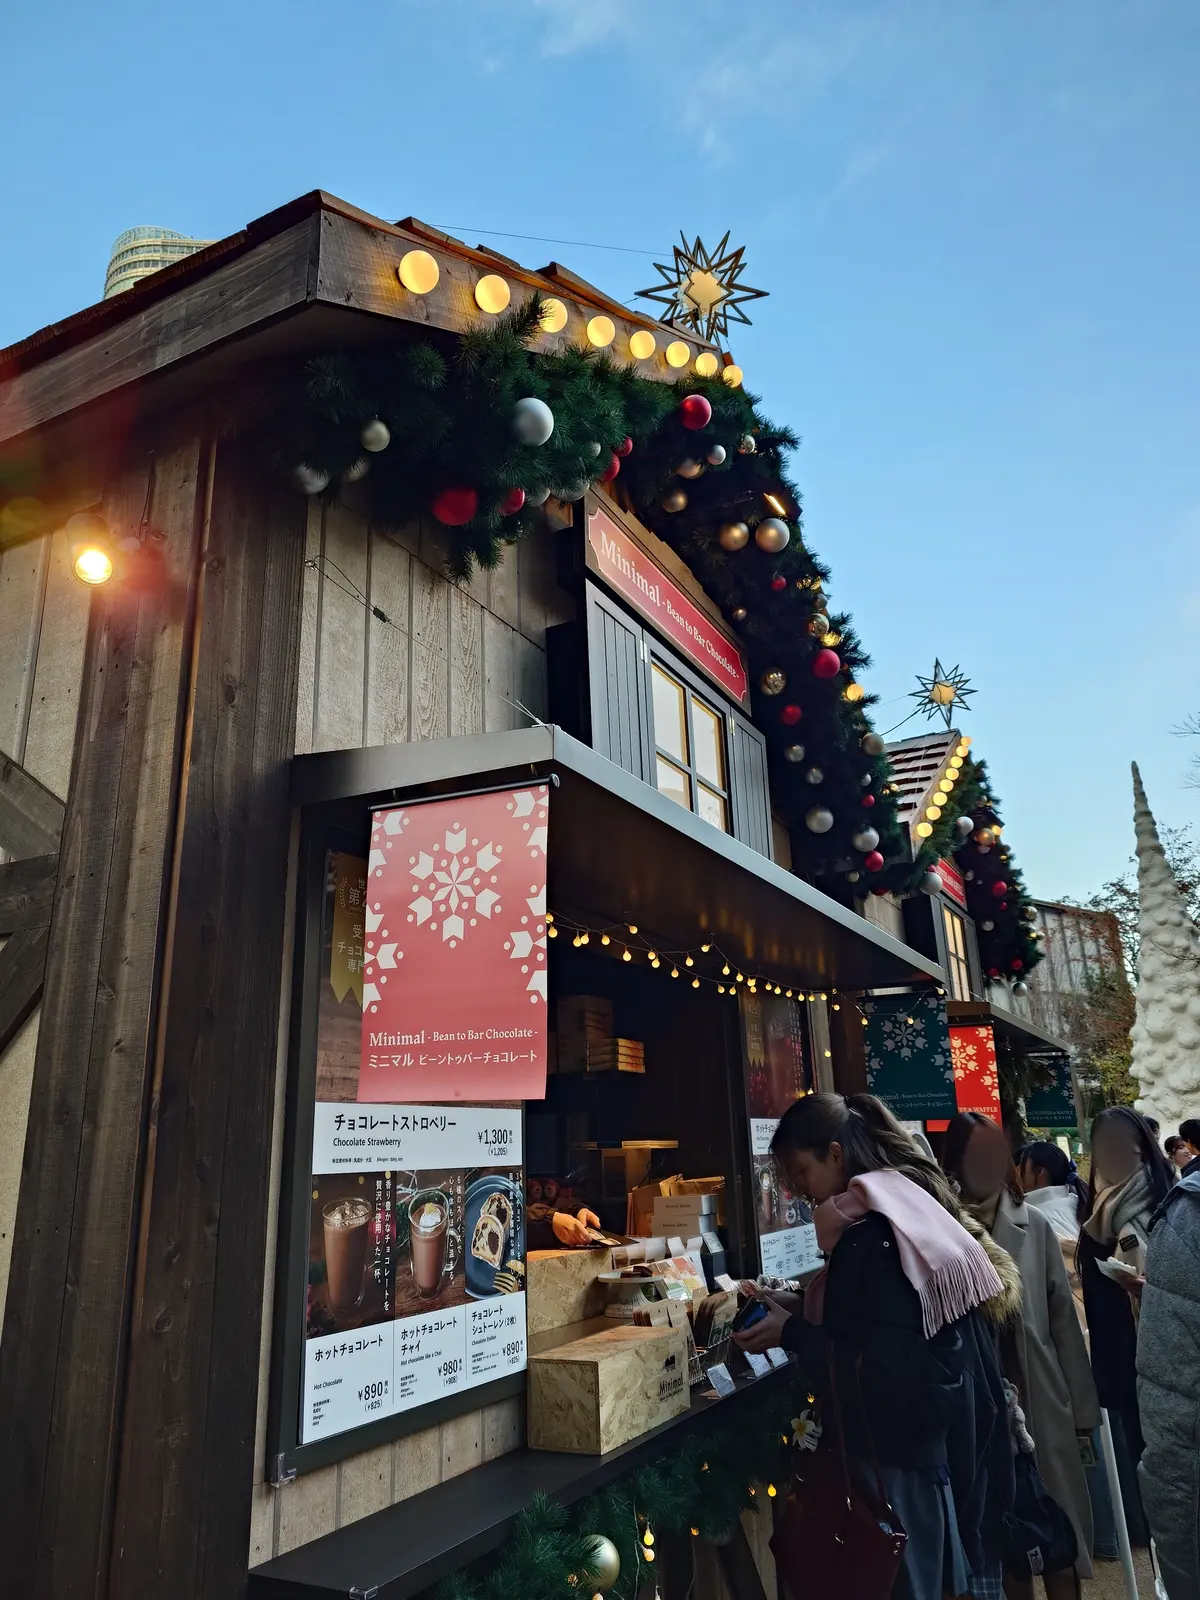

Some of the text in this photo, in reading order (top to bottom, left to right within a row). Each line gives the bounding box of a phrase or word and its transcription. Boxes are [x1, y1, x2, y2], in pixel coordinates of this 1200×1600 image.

[600, 529, 661, 607] Minimal
[666, 599, 685, 628] Bean
[685, 620, 693, 635] to
[693, 626, 706, 648] Bar
[705, 640, 737, 678] Chocolate
[369, 1030, 425, 1047] Minimal
[433, 1031, 455, 1042] Bean
[456, 1031, 466, 1041] to
[467, 1029, 485, 1040] Bar
[485, 1028, 533, 1039] Chocolate
[368, 1050, 538, 1069] ミニマル ビーントゥバーチョコレート
[334, 1113, 457, 1131] チョコレートストロベリー
[333, 1137, 402, 1148] Chocolate Strawberry
[477, 1128, 508, 1147] ¥1,300
[374, 1179, 382, 1285] 贅沢に使用した一杯。
[383, 1179, 392, 1311] 香り豊かなチョコレートを
[472, 1304, 504, 1322] チョコレート
[401, 1316, 458, 1341] ホットチョコレート
[315, 1334, 384, 1362] ホットチョコレート
[401, 1340, 421, 1356] チャイ
[502, 1340, 520, 1357] ¥890
[437, 1359, 458, 1377] ¥980
[313, 1378, 343, 1391] Hot Chocolate
[358, 1381, 383, 1401] ¥890
[659, 1371, 684, 1396] Minimal
[364, 1398, 383, 1412] (¥825)
